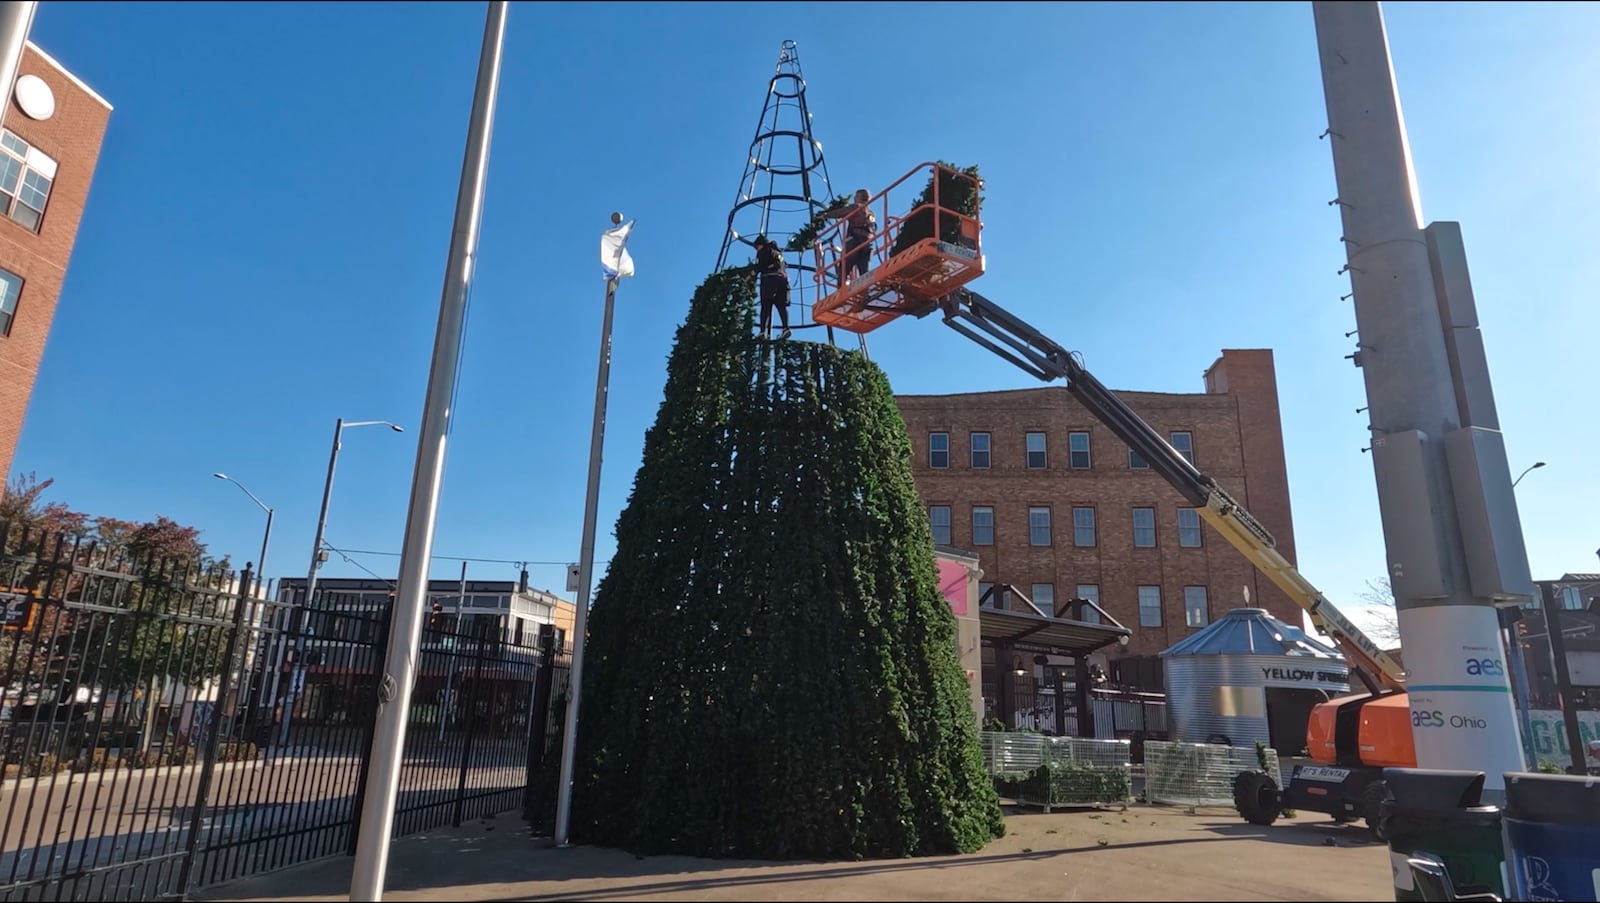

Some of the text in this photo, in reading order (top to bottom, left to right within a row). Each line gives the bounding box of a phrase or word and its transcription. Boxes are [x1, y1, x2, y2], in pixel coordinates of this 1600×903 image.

[1357, 636, 1380, 658] LIFT
[1262, 668, 1314, 681] YELLOW
[1466, 658, 1503, 676] aes
[1412, 710, 1487, 729] aes Ohio
